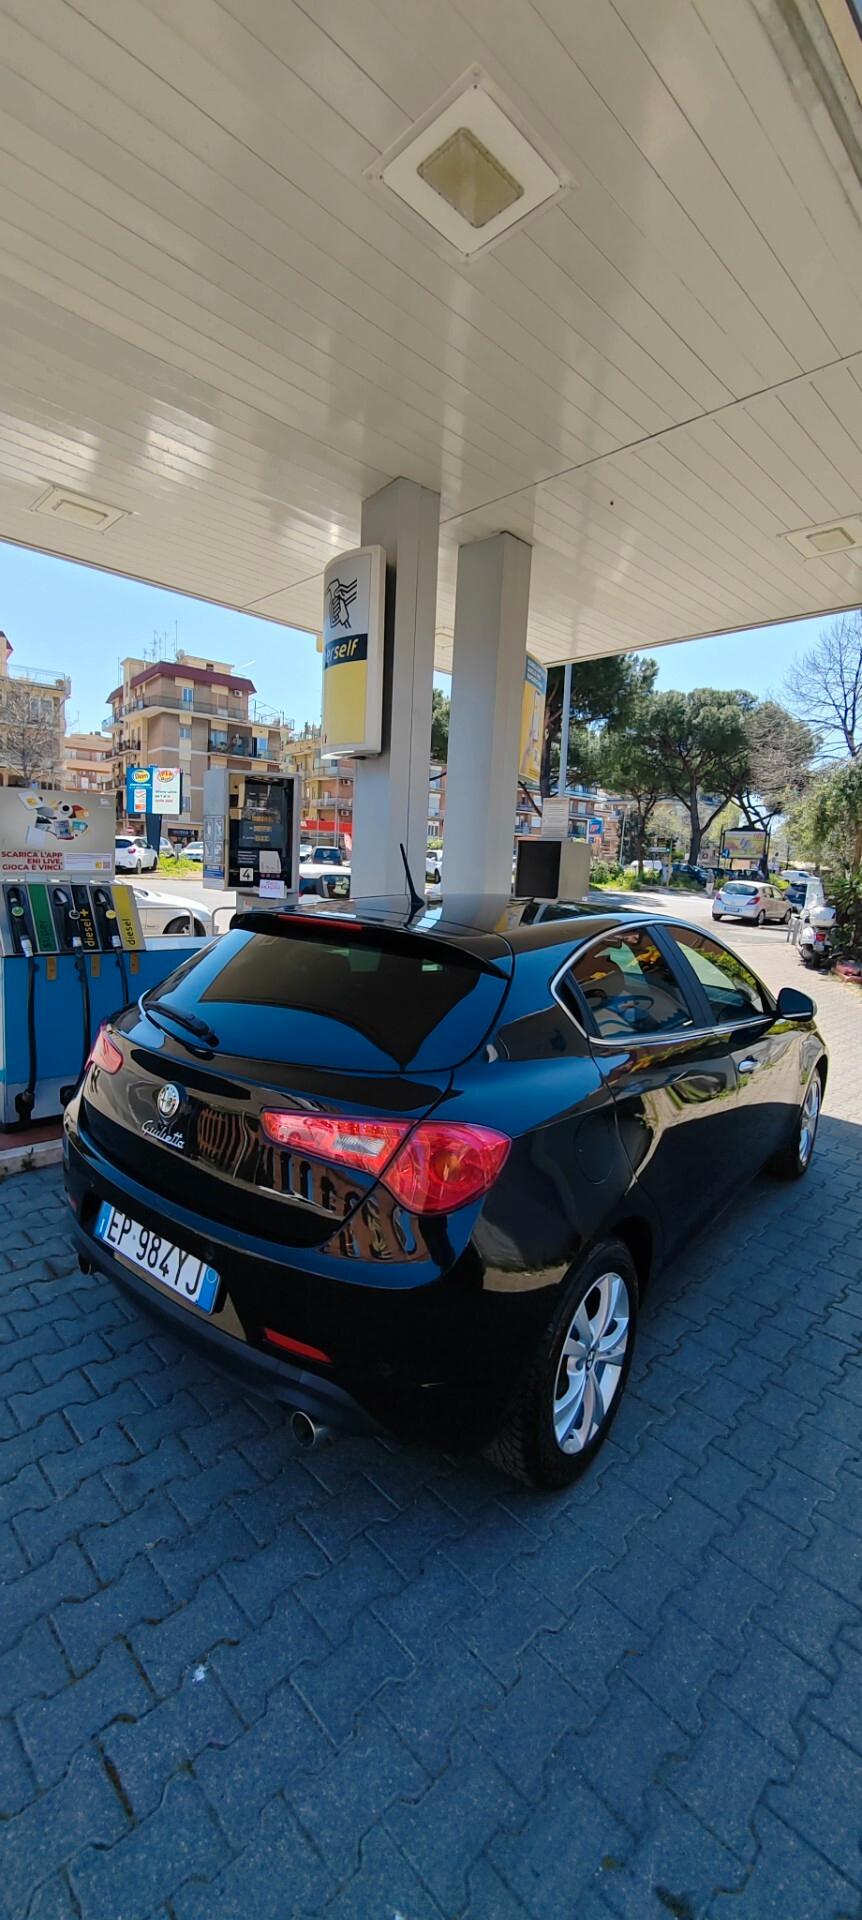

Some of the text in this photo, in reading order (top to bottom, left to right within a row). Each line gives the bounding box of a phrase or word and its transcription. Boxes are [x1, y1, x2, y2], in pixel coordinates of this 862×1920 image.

[242, 869, 250, 881] 4
[121, 918, 136, 946] diesel
[142, 1119, 185, 1149] Giulietta
[106, 1208, 132, 1246] EP
